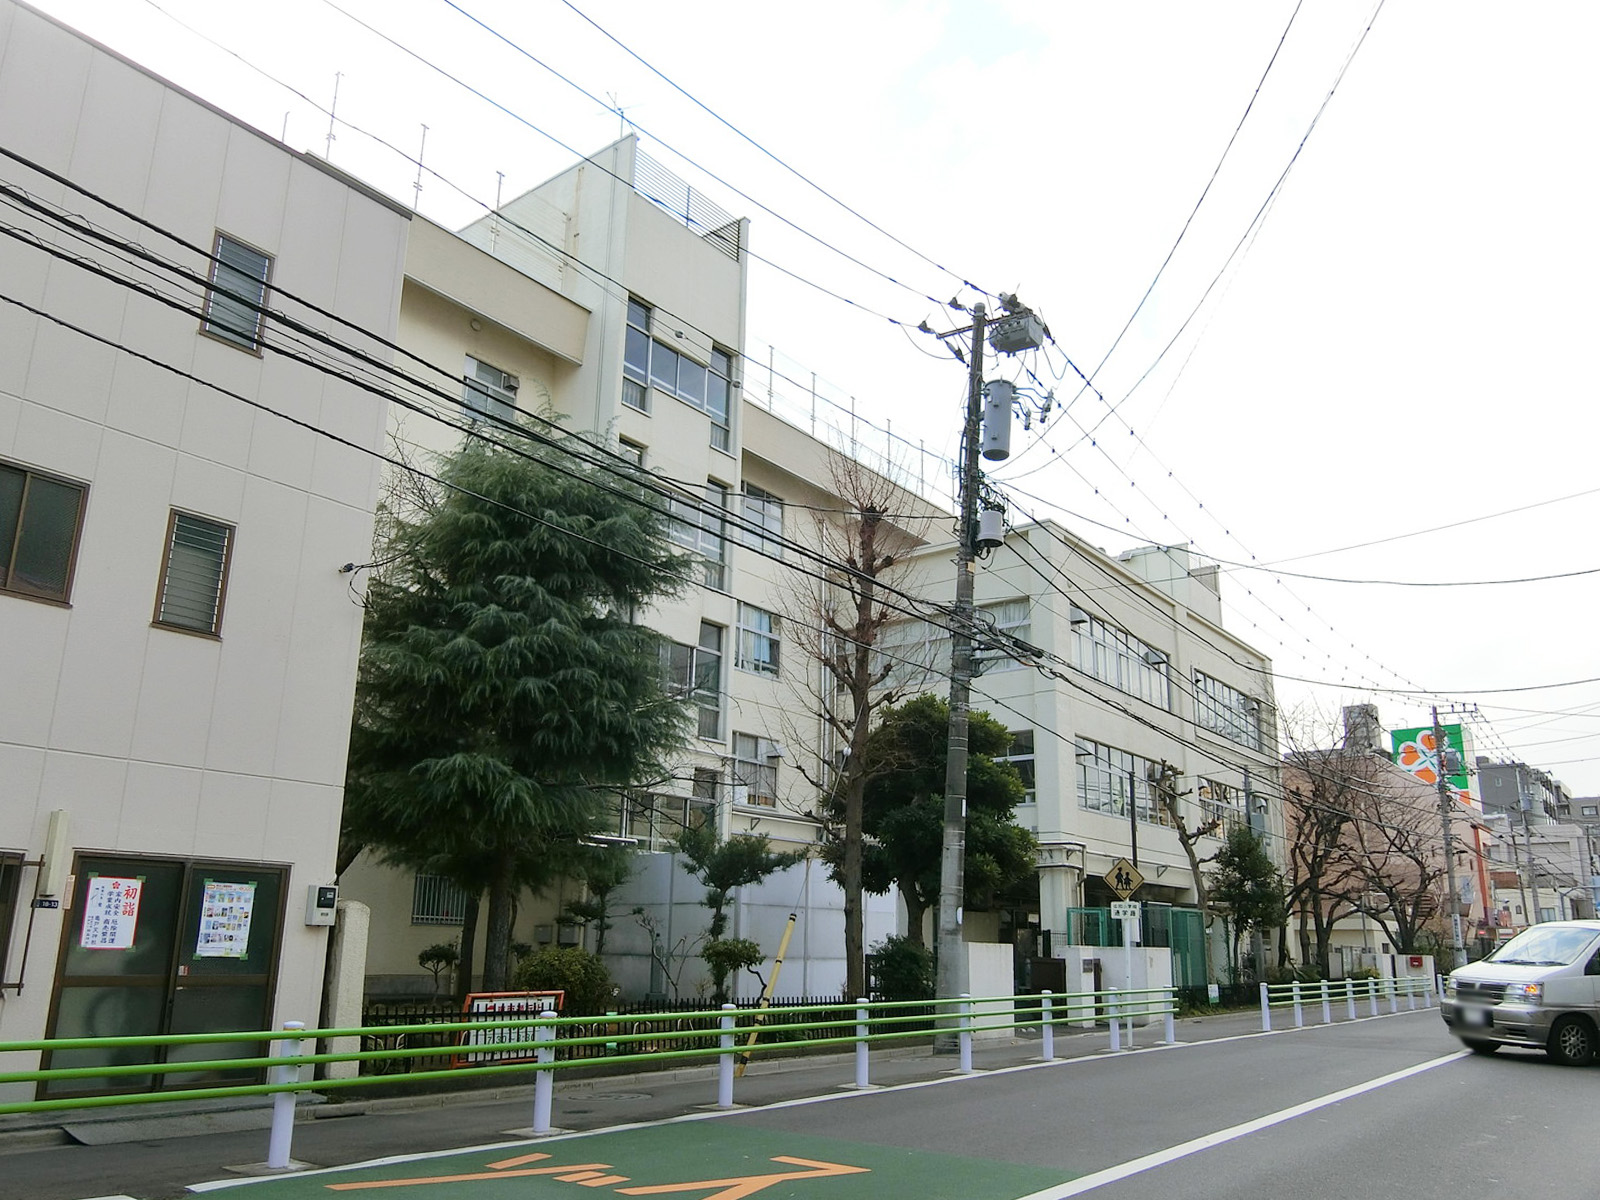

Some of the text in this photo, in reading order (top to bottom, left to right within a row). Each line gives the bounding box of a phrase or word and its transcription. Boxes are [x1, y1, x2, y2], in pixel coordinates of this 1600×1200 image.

[113, 891, 122, 916] 家内安全
[122, 885, 137, 916] 初詣
